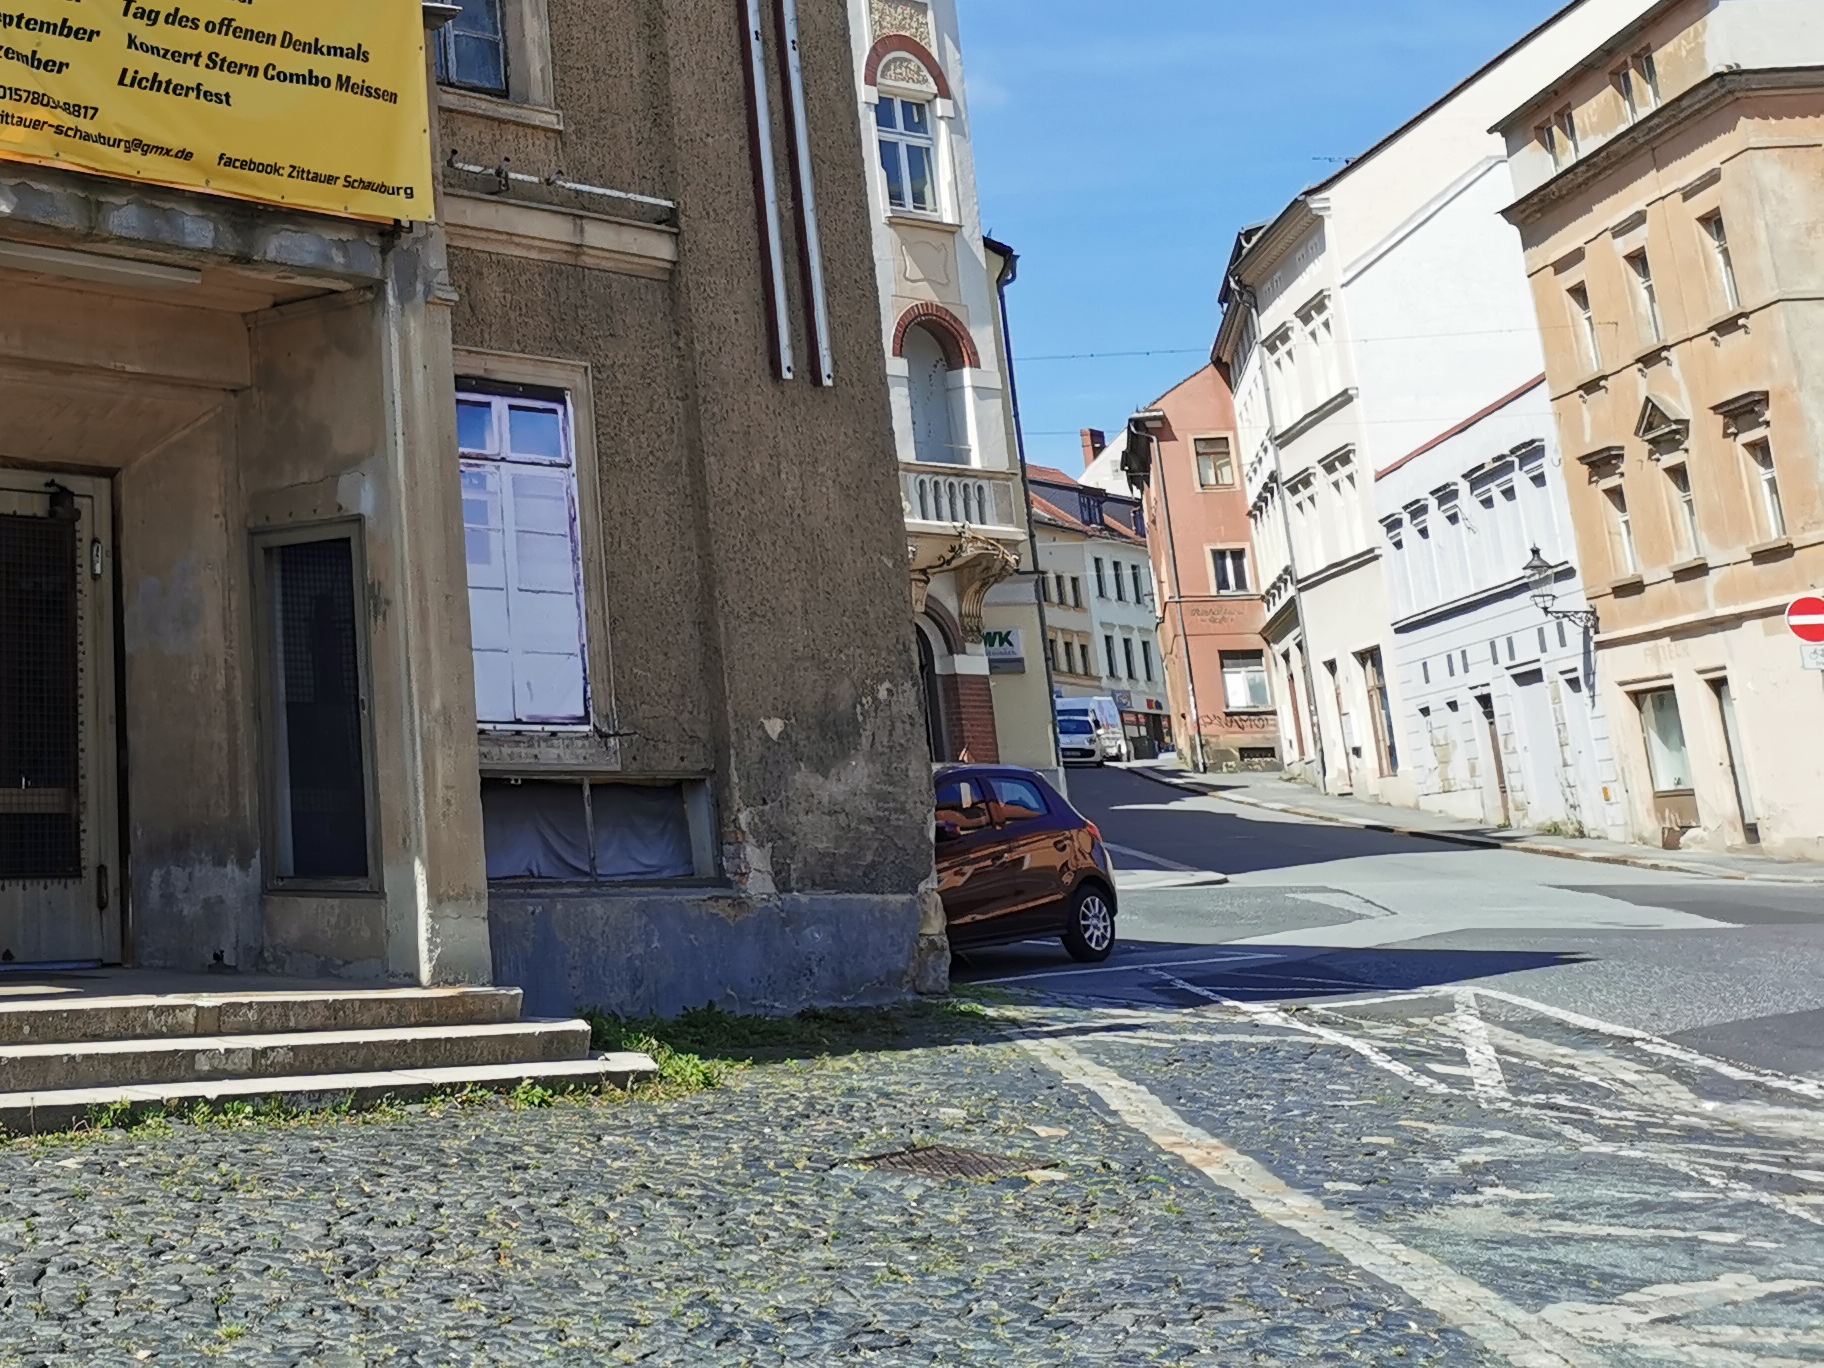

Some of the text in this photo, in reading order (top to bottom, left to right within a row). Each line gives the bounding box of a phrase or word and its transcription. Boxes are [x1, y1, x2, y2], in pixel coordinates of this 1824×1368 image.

[163, 6, 200, 31] des
[204, 16, 277, 47] offenen
[279, 30, 370, 63] Denkmals
[117, 66, 233, 107] Lichterfest
[126, 32, 399, 105] Konzert Stern Combo Meissen
[216, 152, 414, 200] facebook: Zittauer Schauburg
